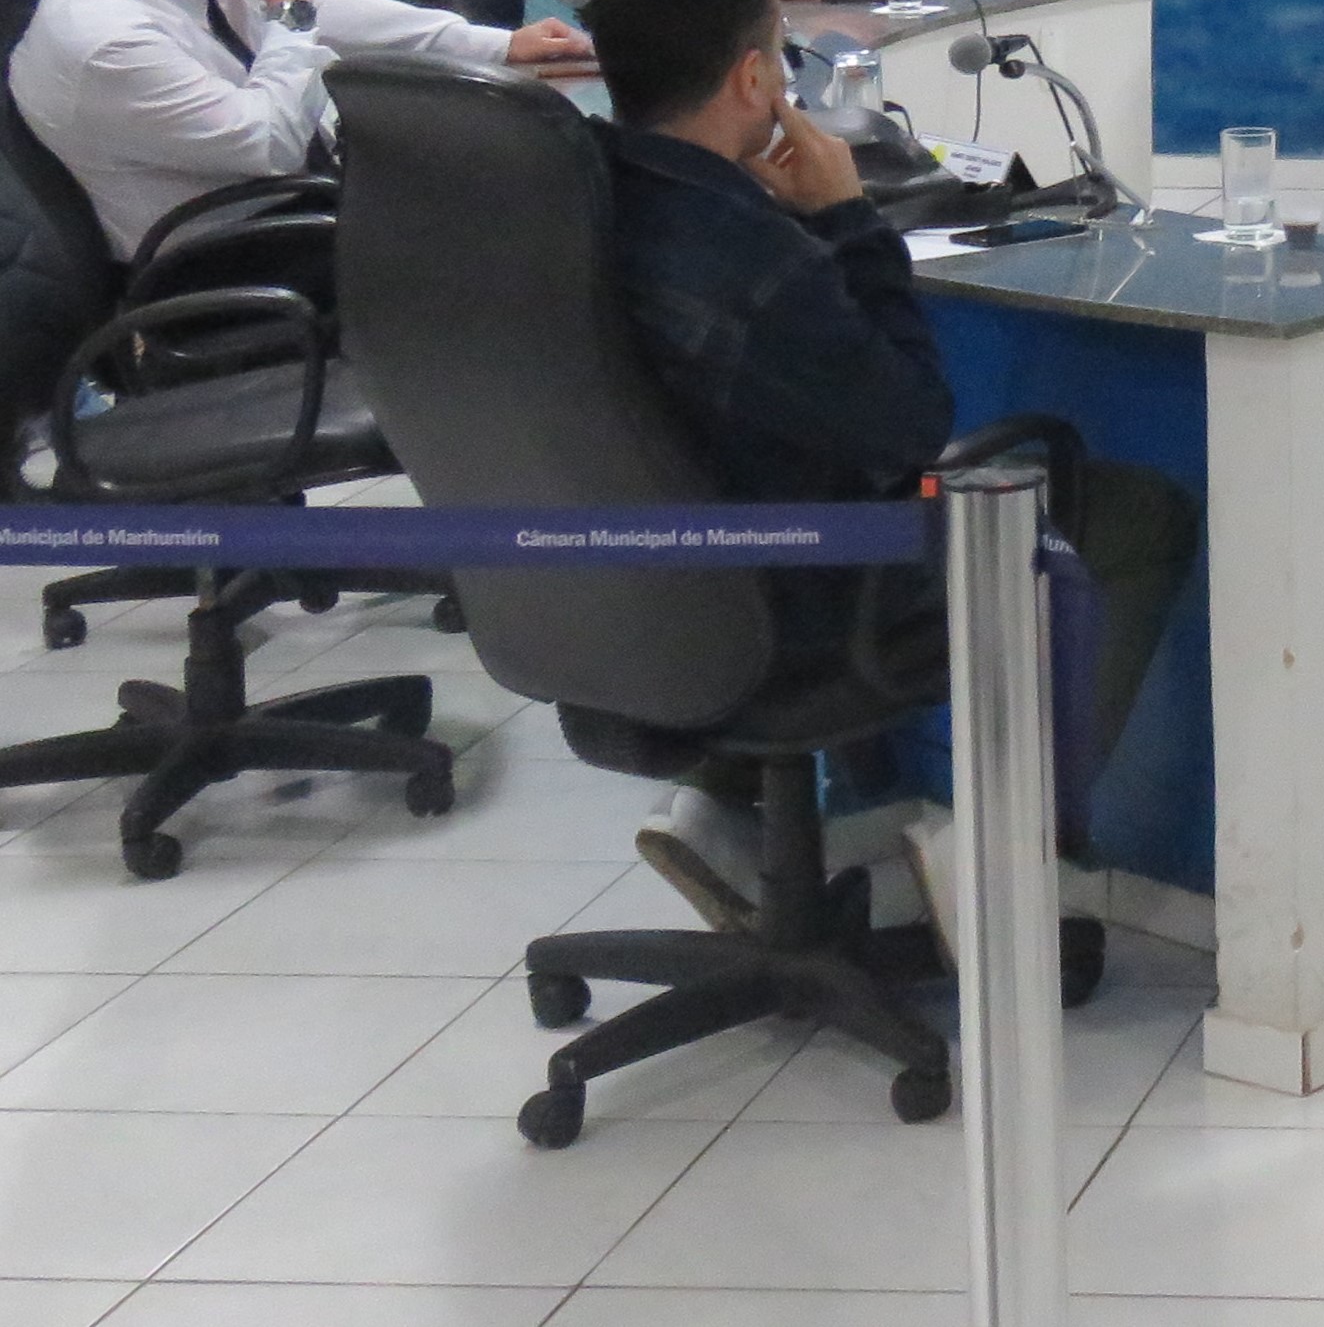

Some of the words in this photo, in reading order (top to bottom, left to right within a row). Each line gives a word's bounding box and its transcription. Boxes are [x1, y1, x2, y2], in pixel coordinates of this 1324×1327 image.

[82, 528, 104, 545] de
[108, 529, 220, 546] Manhumirim
[516, 529, 586, 547] Câmara
[590, 529, 677, 549] Municipal
[681, 530, 701, 546] de
